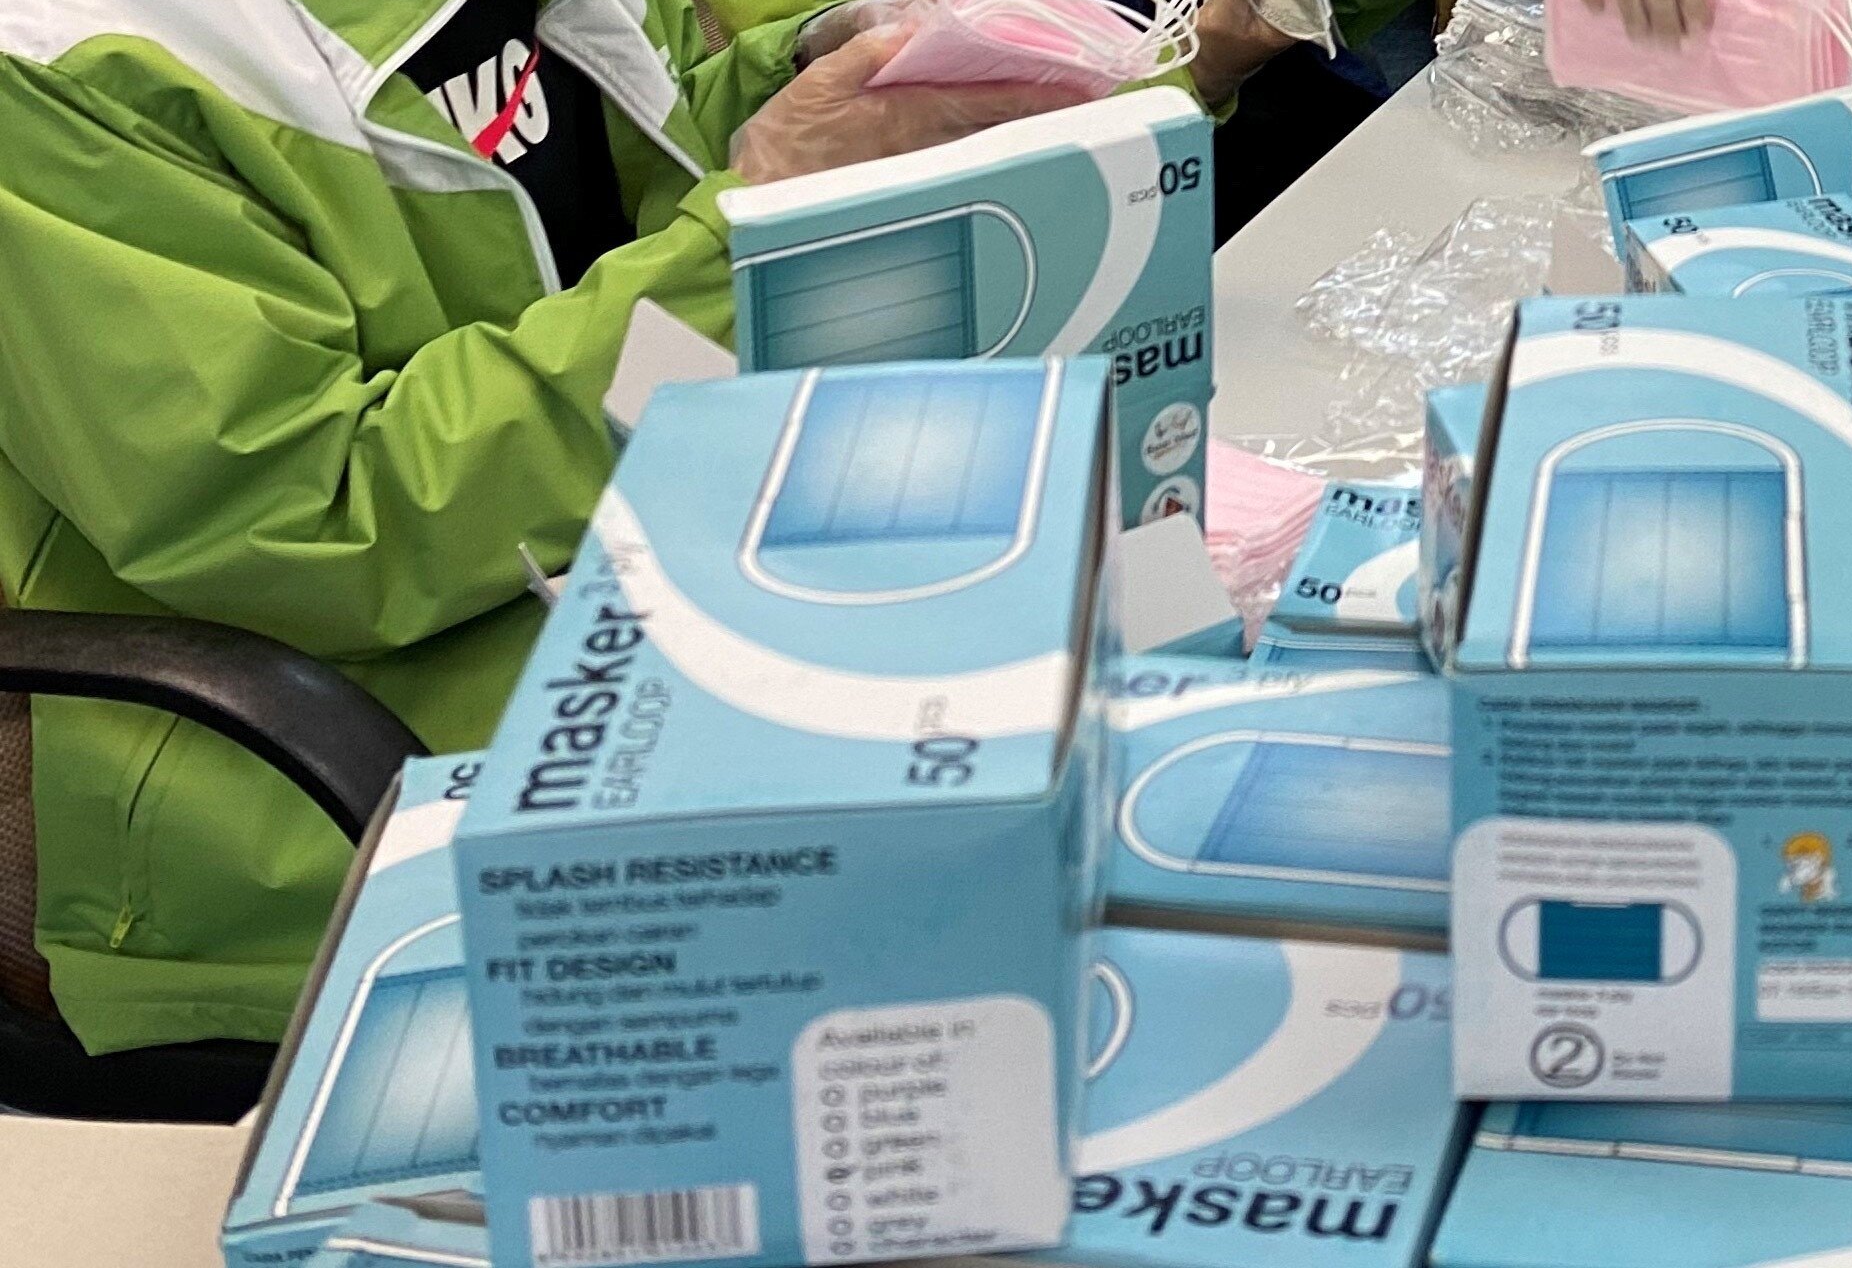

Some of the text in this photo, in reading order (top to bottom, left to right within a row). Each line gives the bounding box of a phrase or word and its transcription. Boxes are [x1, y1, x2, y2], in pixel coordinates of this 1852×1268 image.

[1159, 156, 1202, 196] 50
[1103, 305, 1205, 353] EARLOOP
[1575, 302, 1622, 332] 50
[513, 606, 652, 815] masker
[594, 676, 674, 810] EARLOOP
[908, 737, 980, 787] 50
[479, 845, 839, 895] SPLASH RESISTANCE
[486, 949, 677, 982] FIT DESIGN
[494, 1034, 718, 1069] BREATHABLE
[817, 1022, 944, 1051] Available
[498, 1095, 667, 1126] COMFORT
[1193, 1151, 1415, 1194] EARLOOP
